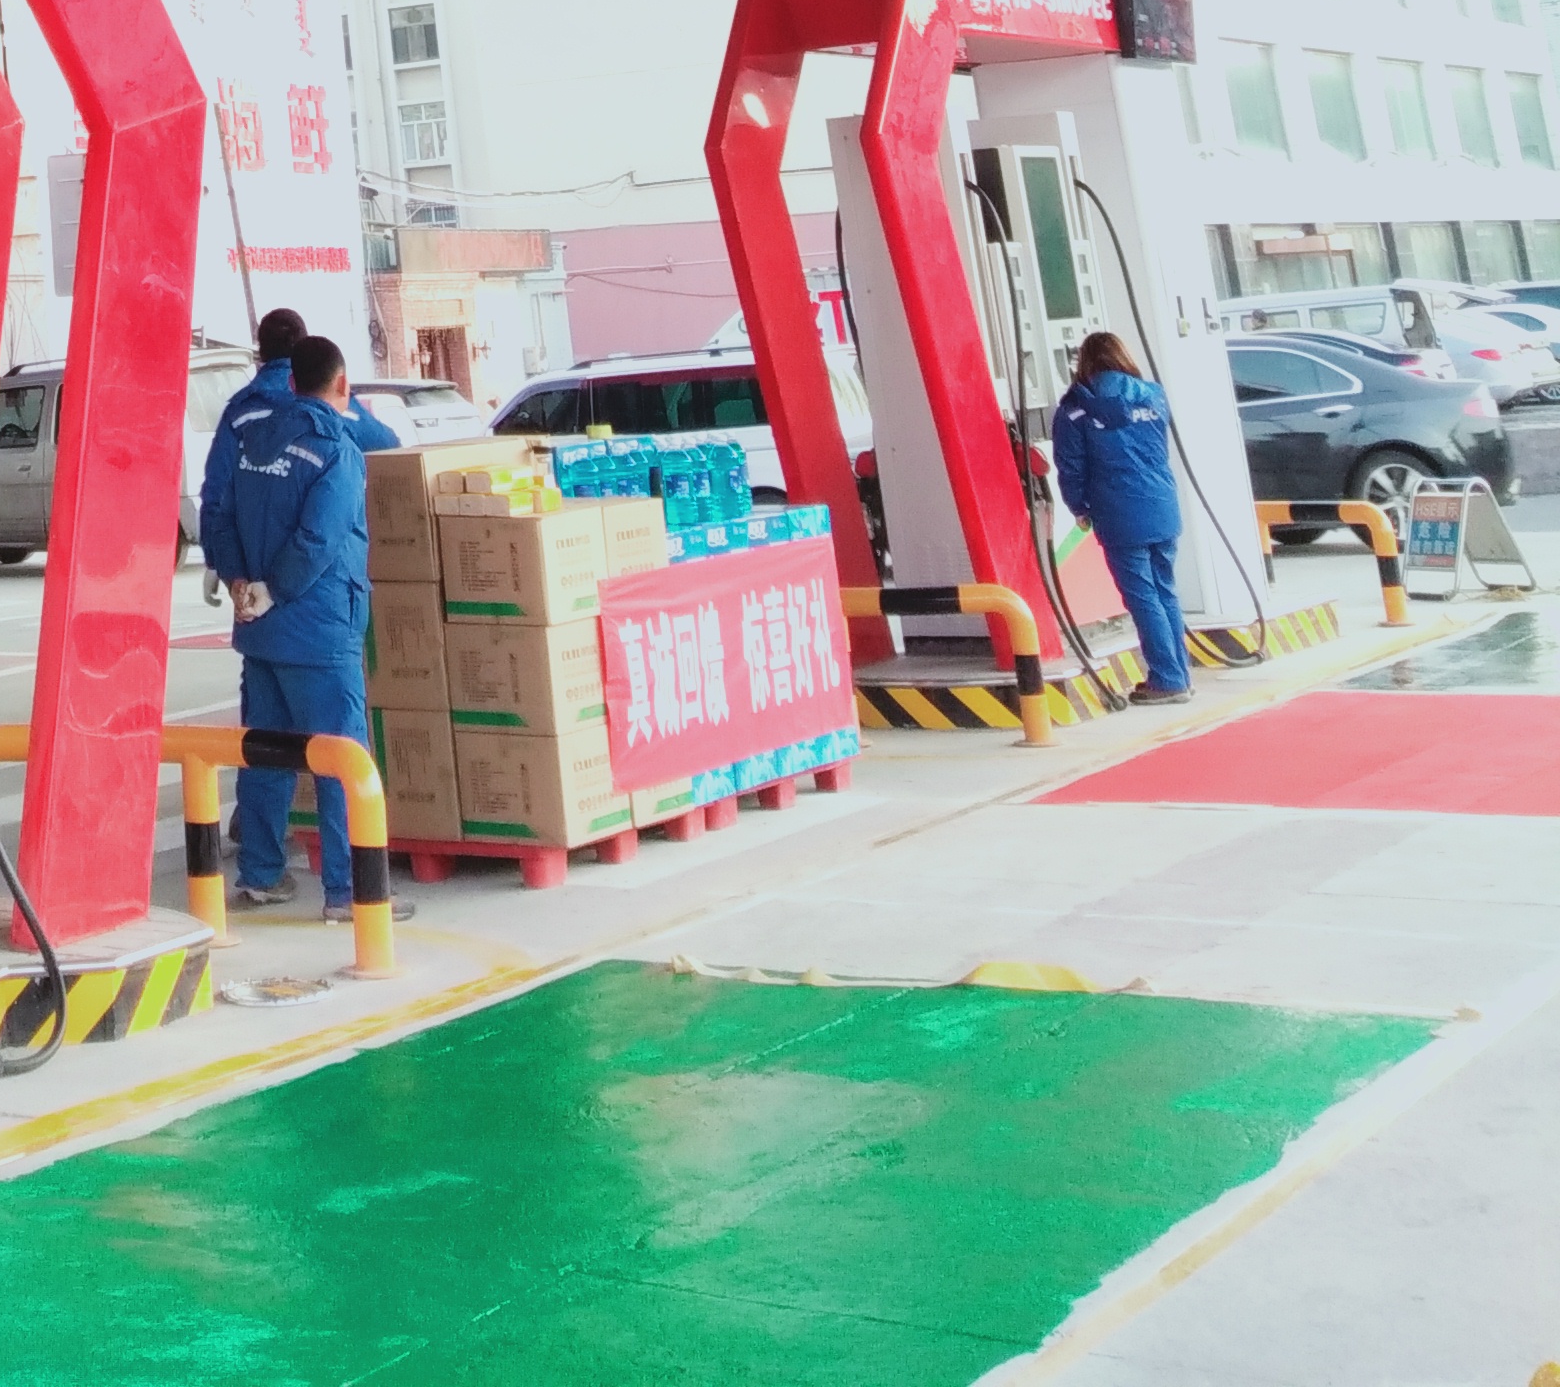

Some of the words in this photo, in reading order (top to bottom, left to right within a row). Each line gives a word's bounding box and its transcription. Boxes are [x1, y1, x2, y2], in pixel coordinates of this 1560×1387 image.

[617, 600, 730, 748] 真诚回馈
[742, 578, 840, 714] 惊喜好礼
